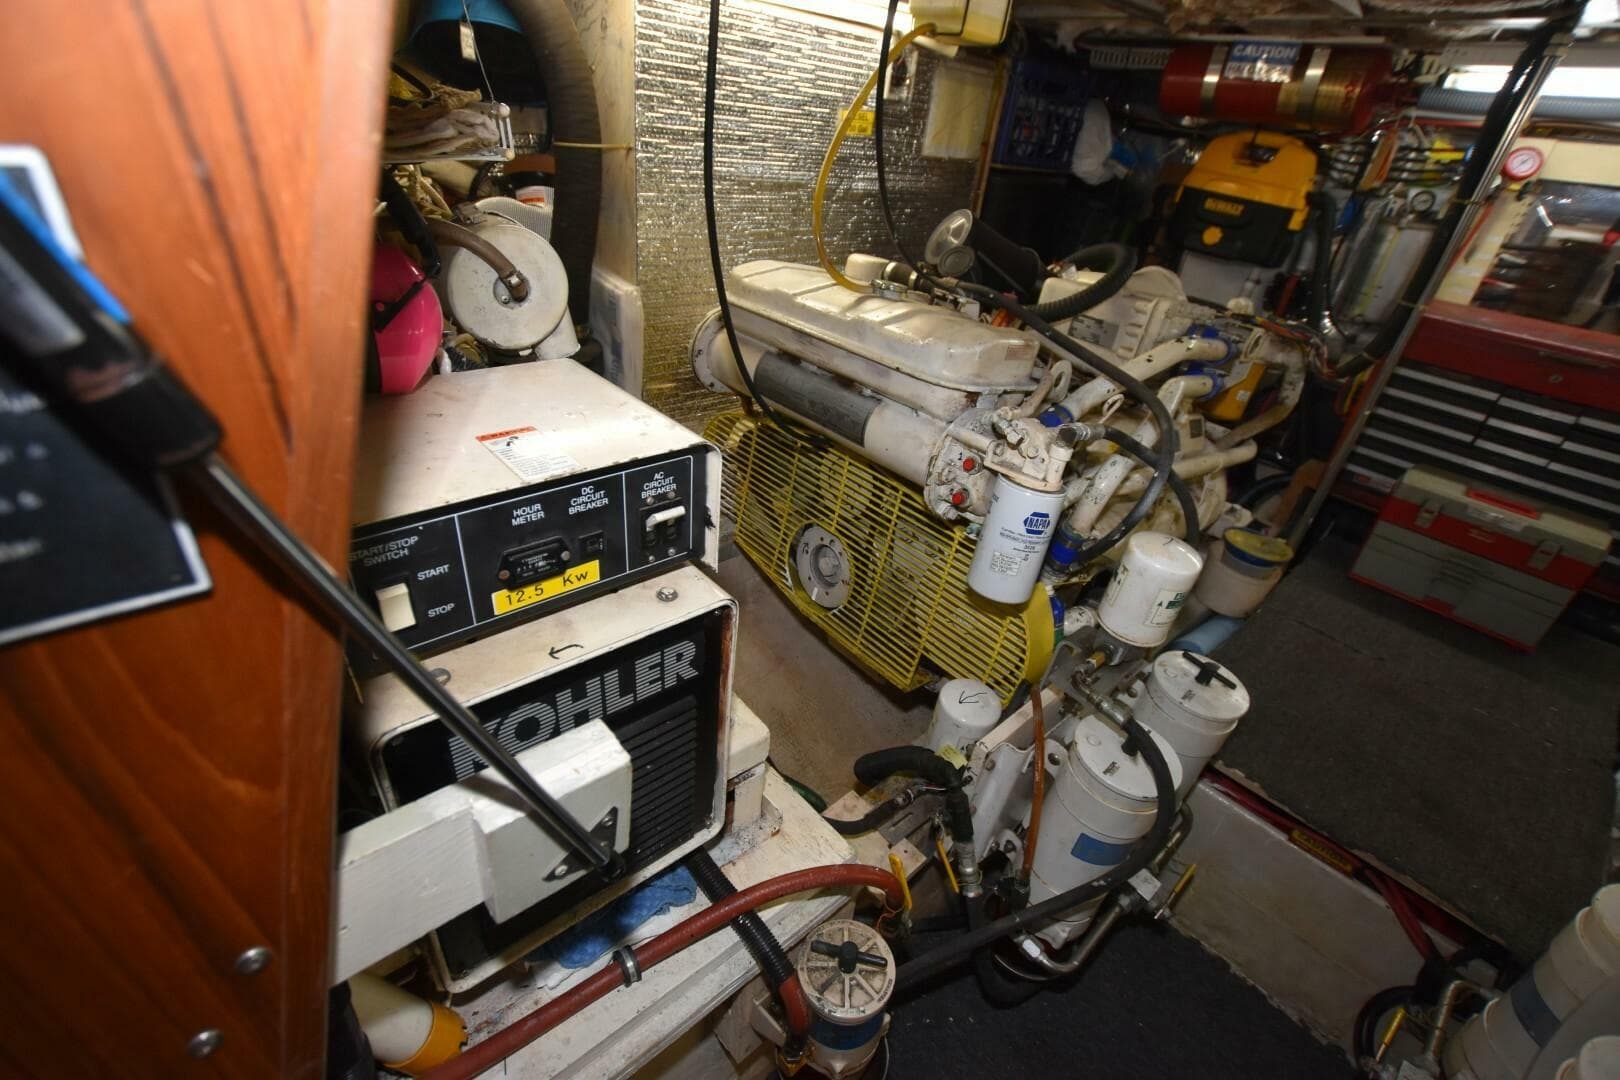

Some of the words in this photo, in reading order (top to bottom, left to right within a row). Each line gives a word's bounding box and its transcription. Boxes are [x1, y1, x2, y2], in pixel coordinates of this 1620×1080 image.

[1233, 45, 1297, 59] CAUTION
[643, 476, 674, 490] CIRCUIT
[653, 472, 664, 480] AC
[581, 485, 594, 495] DC
[641, 484, 677, 499] BREAKER
[570, 490, 606, 506] CIRCUIT
[513, 503, 542, 517] HOUR
[568, 498, 609, 515] BREAKER
[511, 511, 545, 526] METER
[1026, 518, 1048, 530] NAPA
[363, 548, 410, 567] SWITCH
[417, 564, 450, 580] START
[506, 583, 544, 606] 12.5
[427, 602, 456, 618] STOP
